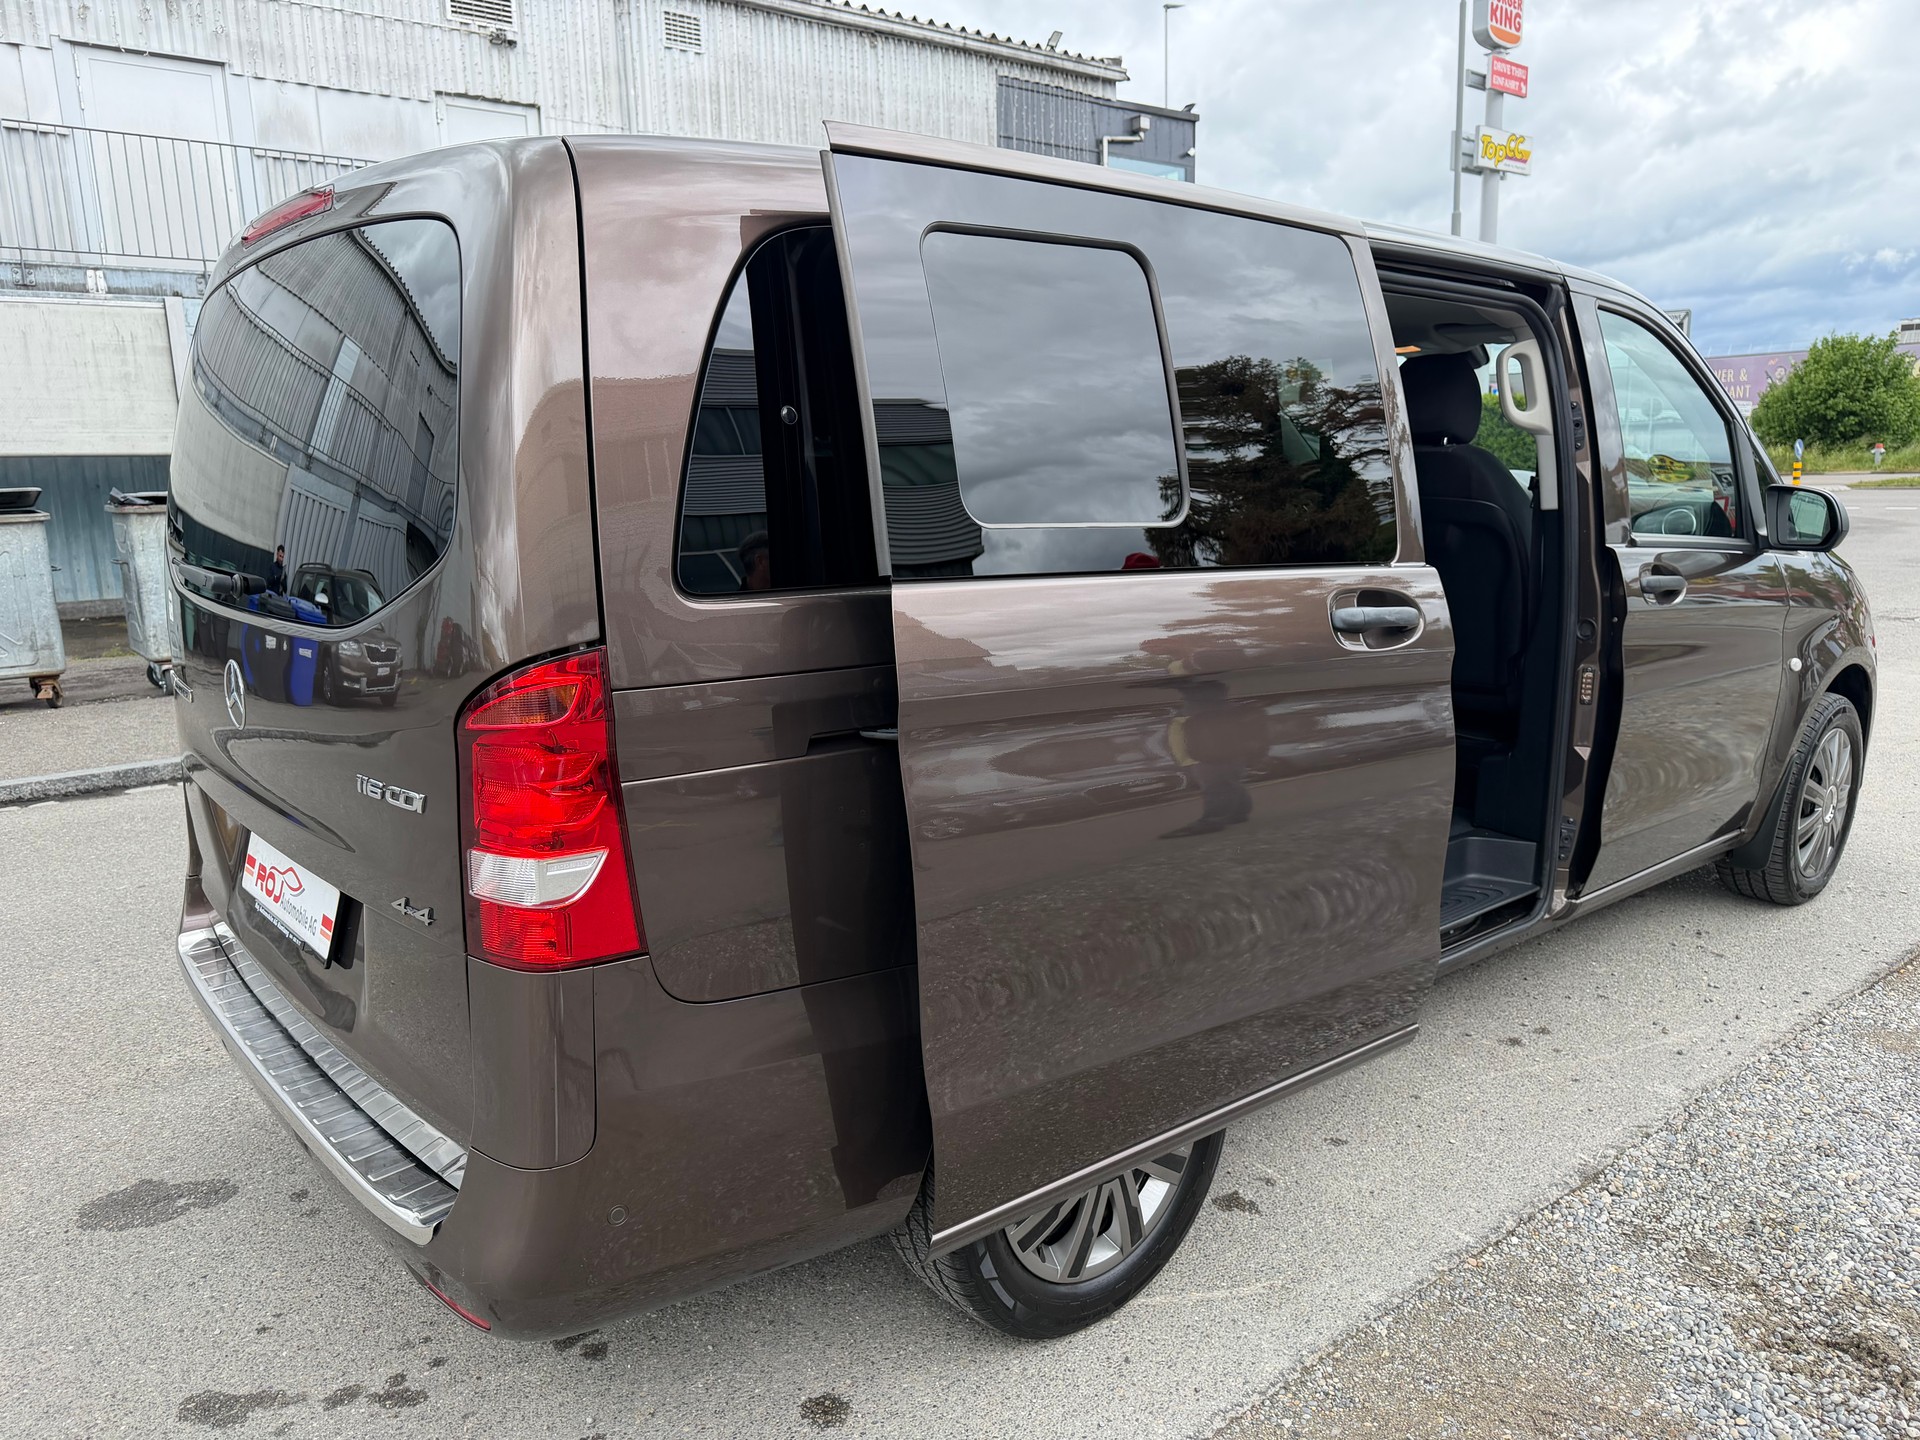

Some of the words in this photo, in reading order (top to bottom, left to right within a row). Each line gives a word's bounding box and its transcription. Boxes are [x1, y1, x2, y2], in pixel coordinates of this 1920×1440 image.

[1490, 1, 1521, 33] KING
[1493, 60, 1511, 75] DRIVE
[1511, 65, 1526, 80] THRU
[1481, 133, 1525, 168] TopCC
[1739, 367, 1748, 382] &
[384, 784, 427, 815] CDI
[255, 862, 284, 904] ROJ
[280, 892, 309, 930] Automobile
[307, 915, 318, 937] AG
